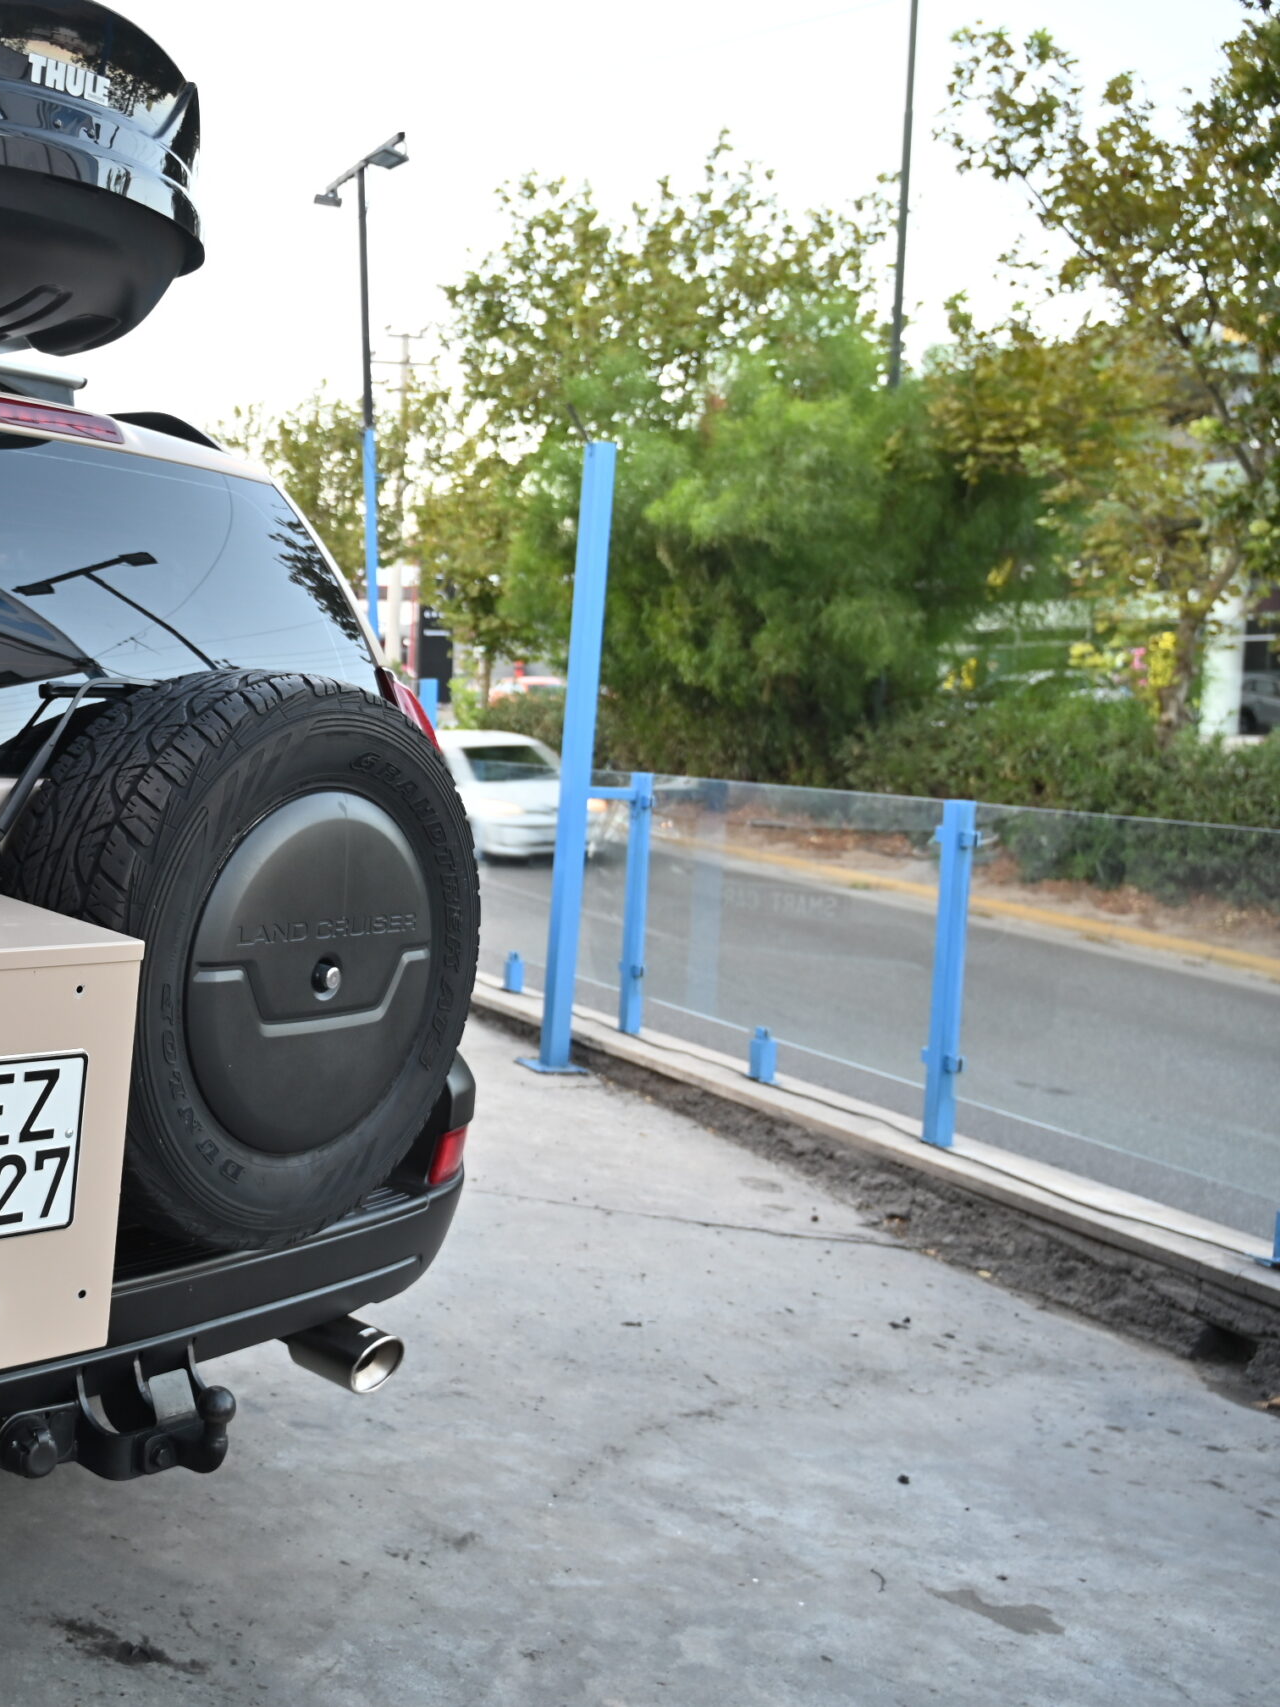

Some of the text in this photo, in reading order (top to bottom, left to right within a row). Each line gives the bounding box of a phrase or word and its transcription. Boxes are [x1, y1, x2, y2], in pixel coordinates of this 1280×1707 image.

[28, 53, 111, 107] THULE
[349, 751, 463, 974] GRANDTREK
[236, 912, 418, 947] LAND CRUISER
[160, 982, 248, 1185] DUNLOP
